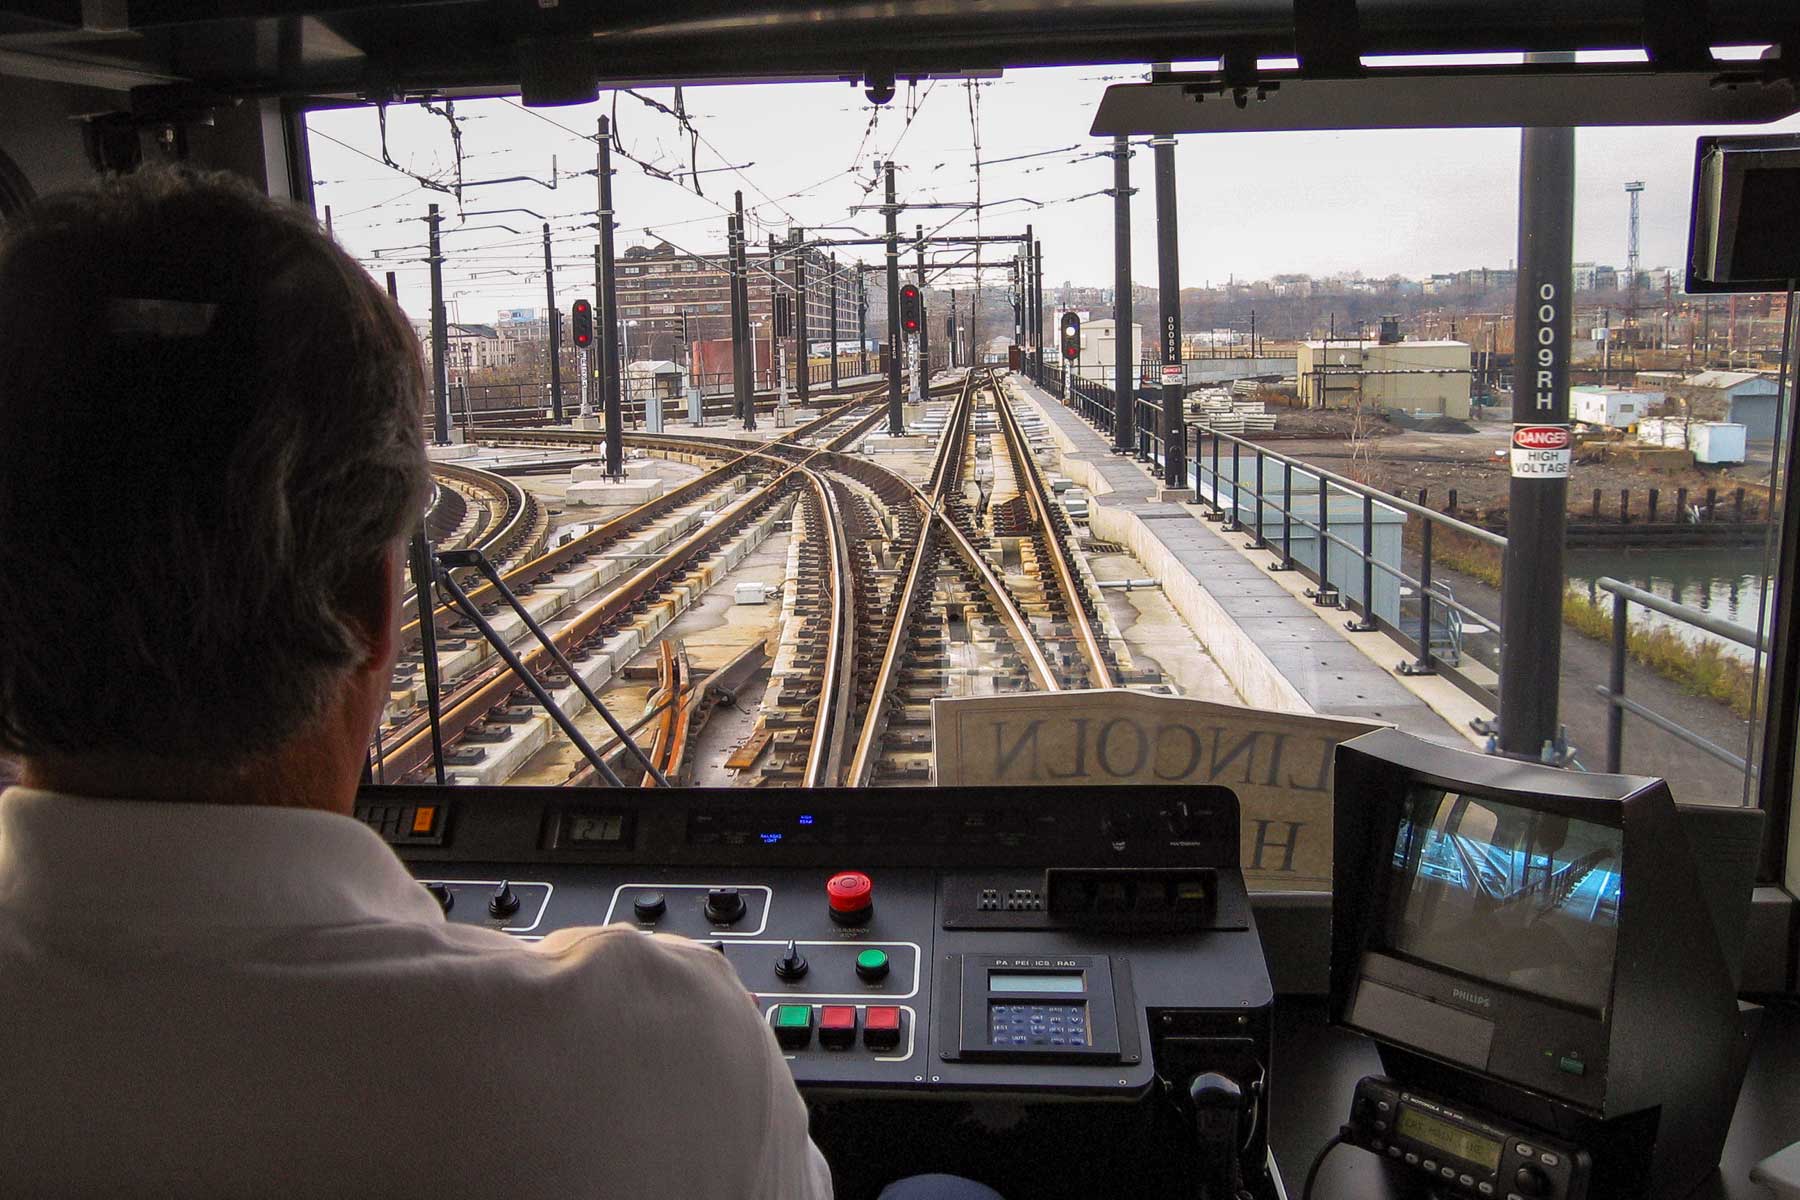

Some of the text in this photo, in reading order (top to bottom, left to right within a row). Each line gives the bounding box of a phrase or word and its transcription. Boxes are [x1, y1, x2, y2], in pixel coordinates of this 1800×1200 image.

[1535, 283, 1555, 410] 0009RH
[1528, 451, 1559, 461] HIGH
[1516, 463, 1567, 473] VOLTAGE
[1452, 988, 1489, 1007] PHILIPS
